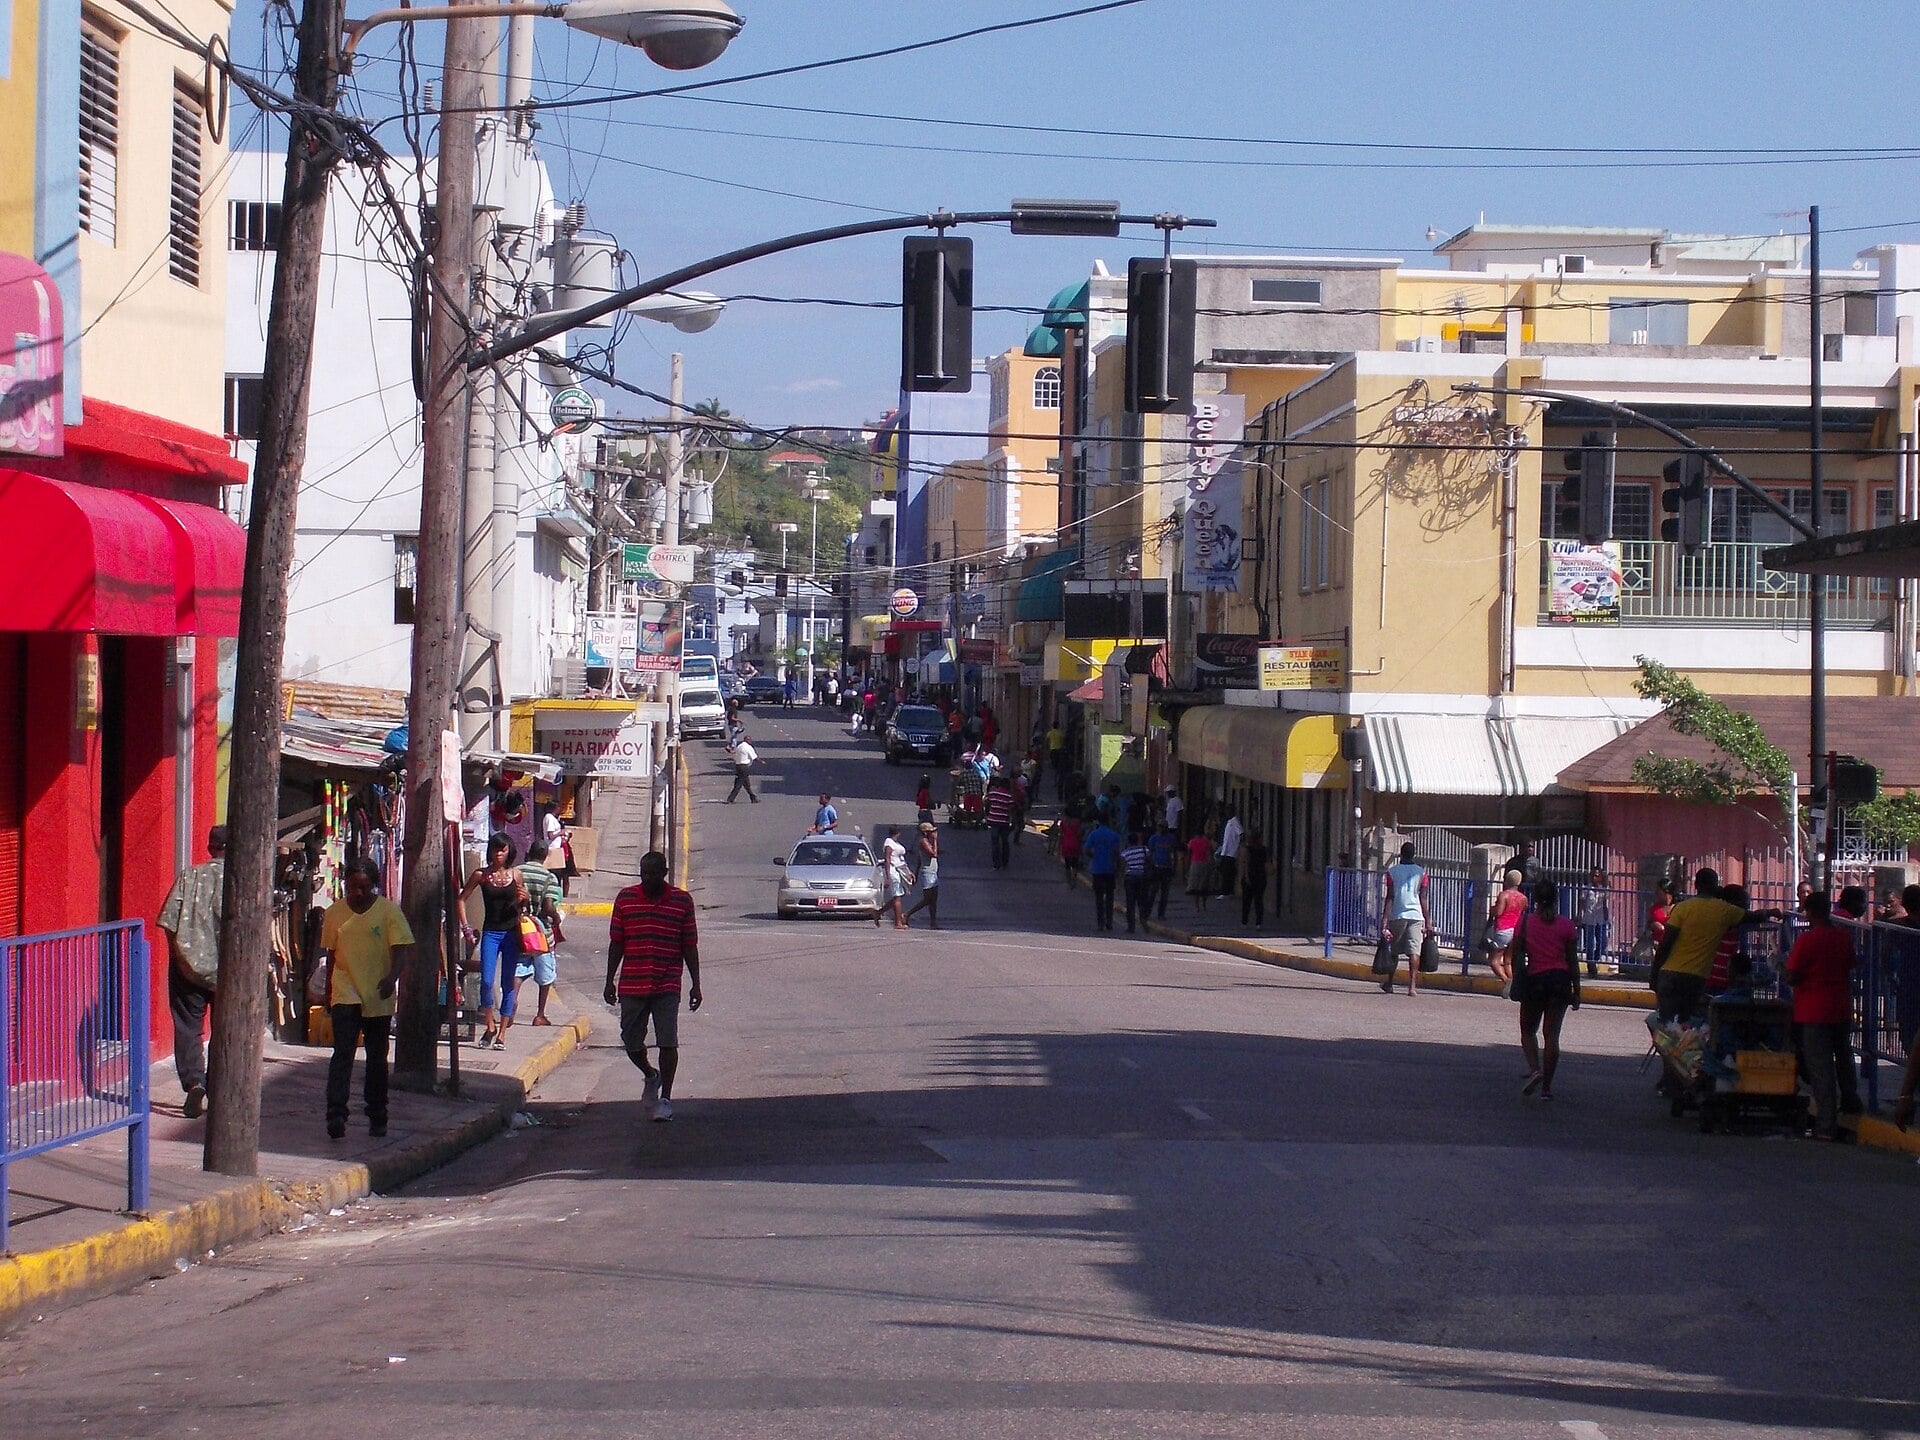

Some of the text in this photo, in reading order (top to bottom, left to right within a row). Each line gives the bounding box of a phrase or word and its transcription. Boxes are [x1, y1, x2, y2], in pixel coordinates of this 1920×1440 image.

[555, 406, 591, 415] Heineken
[1193, 402, 1219, 491] Beauty
[1193, 499, 1217, 569] Queen
[648, 551, 689, 562] COMTREX
[592, 631, 632, 645] Interet
[1224, 655, 1248, 664] zero
[1264, 660, 1340, 670] RESTAURANT
[594, 728, 620, 737] CARE
[551, 741, 643, 756] PHARMACY
